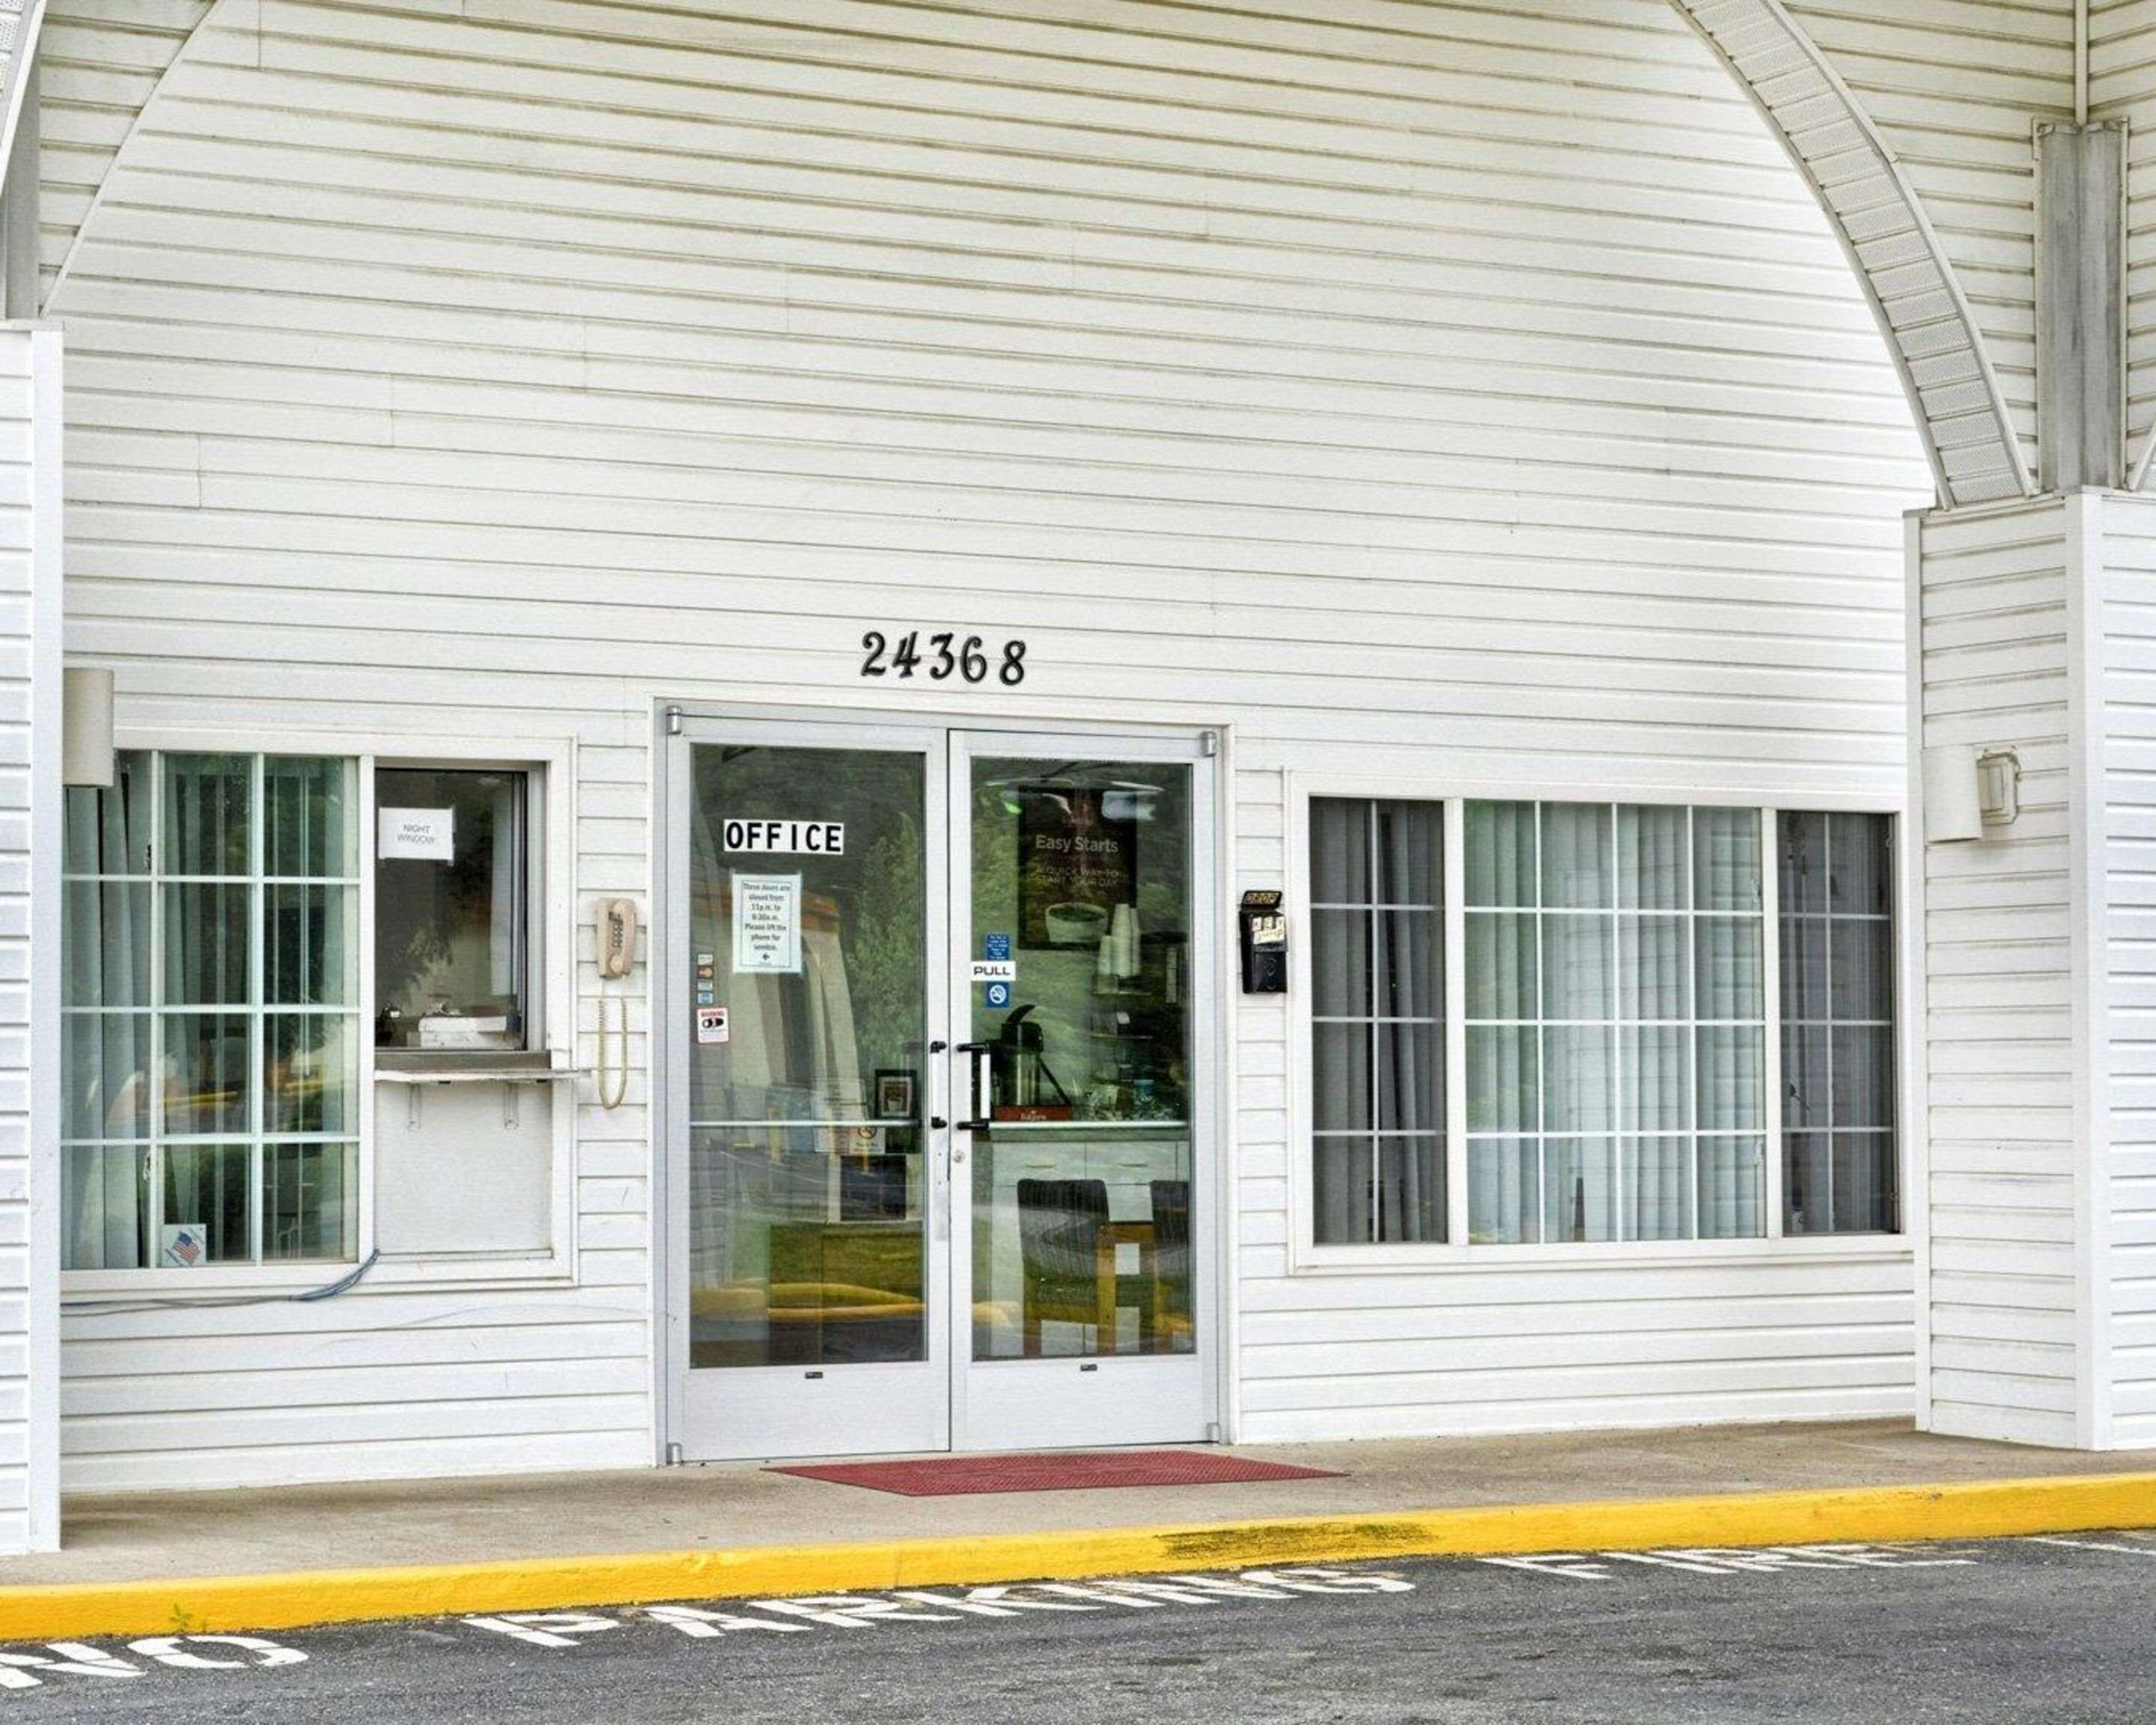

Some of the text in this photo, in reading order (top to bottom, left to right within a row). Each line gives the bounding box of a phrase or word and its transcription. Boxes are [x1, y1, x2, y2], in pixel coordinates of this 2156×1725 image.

[862, 631, 1026, 686] 24368
[403, 824, 431, 833] NIGHT
[398, 833, 435, 845] WINDOW
[725, 821, 841, 852] OFFICE
[1036, 835, 1119, 853] Easy Starts
[1047, 866, 1079, 876] QUICK
[1080, 867, 1102, 877] WAY
[1105, 868, 1120, 878] TO
[1098, 877, 1118, 887] DAY
[744, 922, 765, 931] Please
[974, 966, 1011, 976] PULL
[0, 1635, 309, 1689] NO
[460, 1569, 1416, 1647] PARKING
